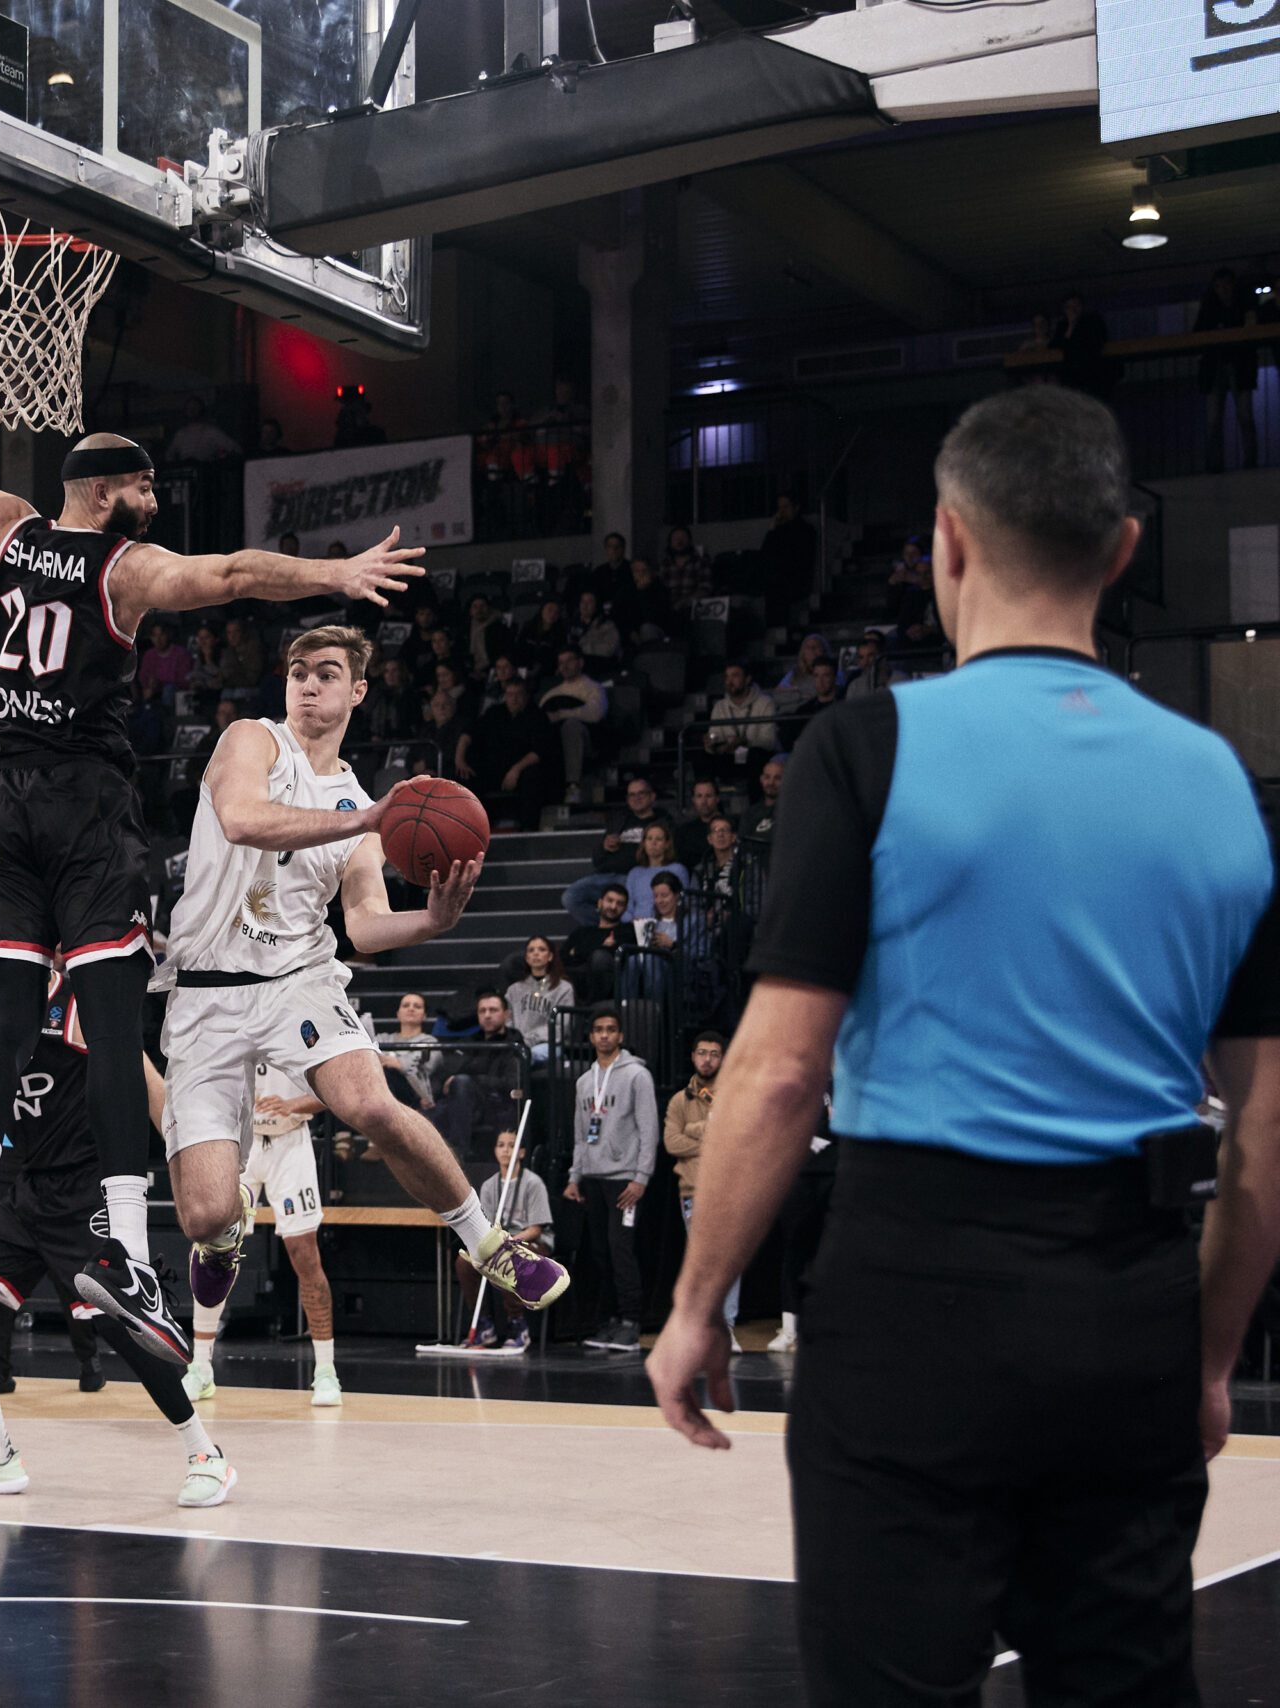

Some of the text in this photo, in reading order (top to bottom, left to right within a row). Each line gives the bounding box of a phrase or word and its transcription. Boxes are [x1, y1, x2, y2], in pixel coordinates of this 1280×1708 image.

[267, 458, 445, 538] DIRECTION
[4, 538, 86, 583] SHARMA
[242, 923, 278, 947] BLACK
[298, 1187, 316, 1212] 13
